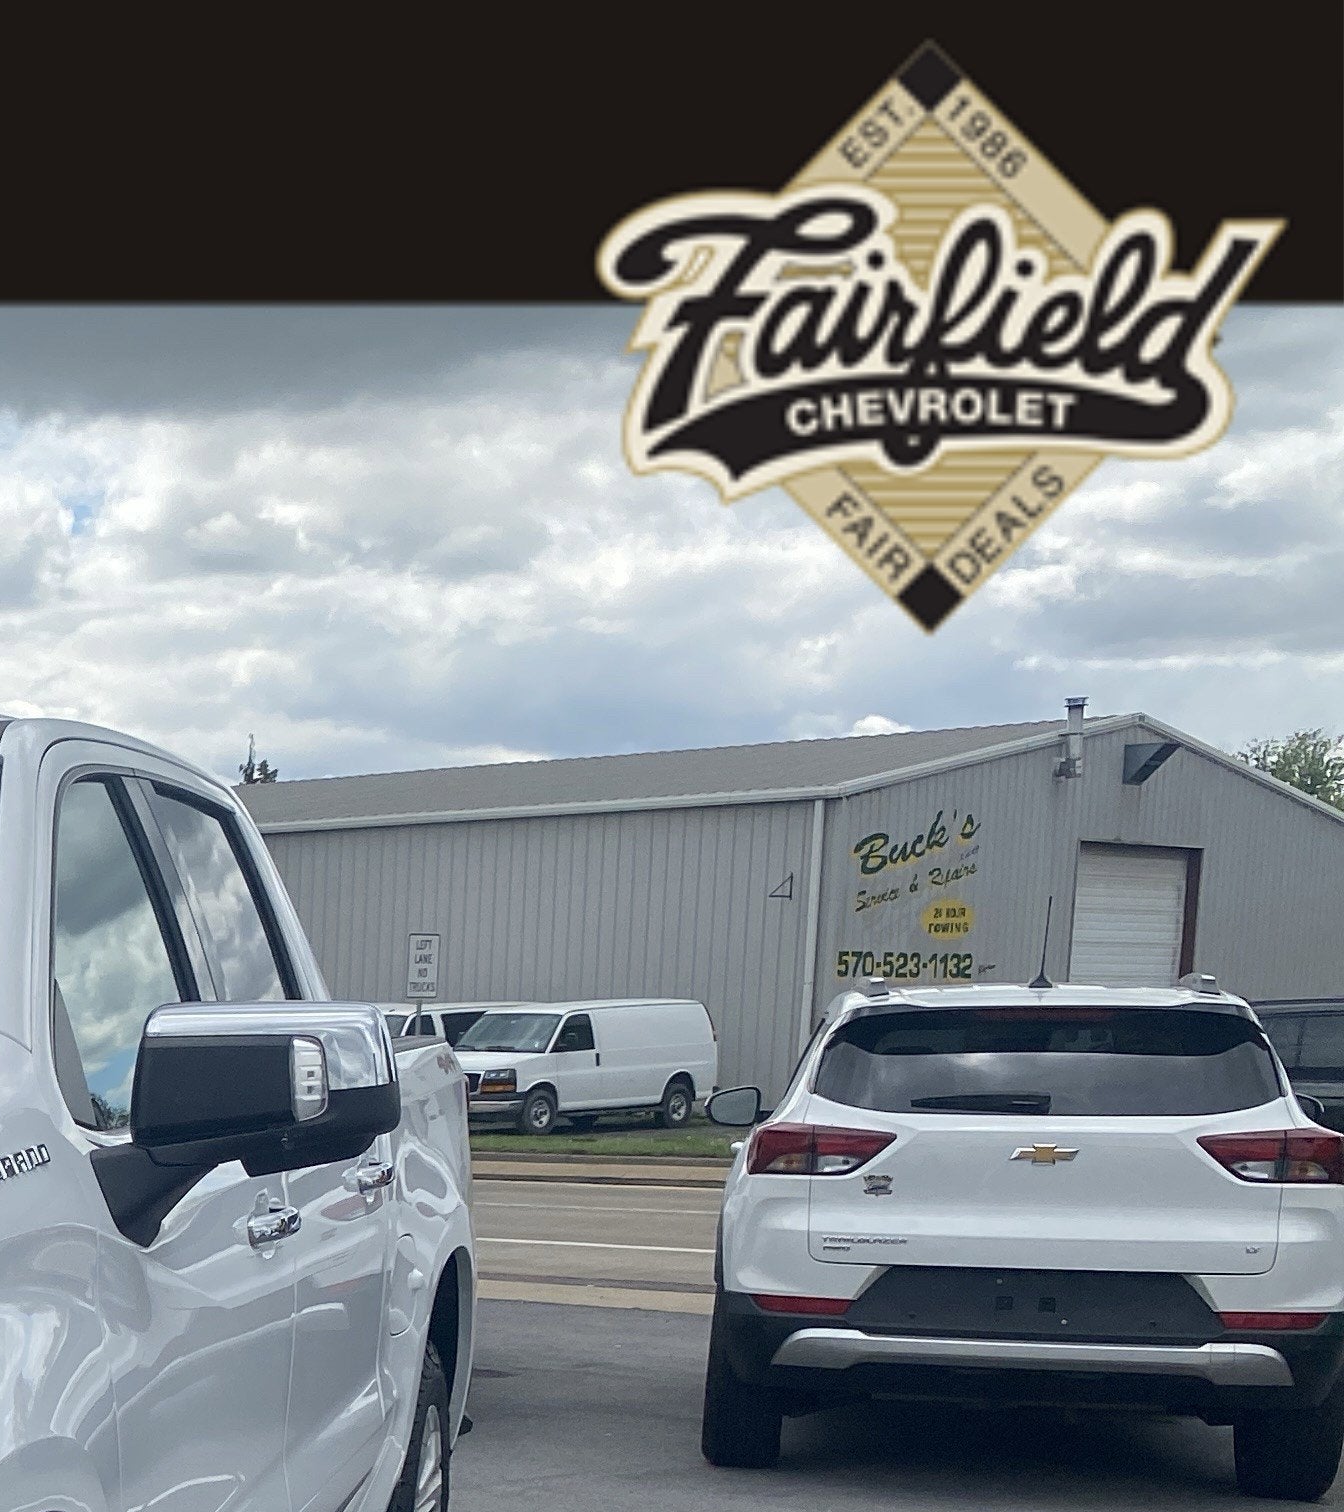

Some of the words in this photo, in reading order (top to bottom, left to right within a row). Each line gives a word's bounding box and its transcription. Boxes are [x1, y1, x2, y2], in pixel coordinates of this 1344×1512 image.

[853, 808, 982, 875] Buck's
[928, 922, 969, 934] TOWING
[414, 953, 433, 964] LANE
[837, 950, 973, 979] 570-523-1132
